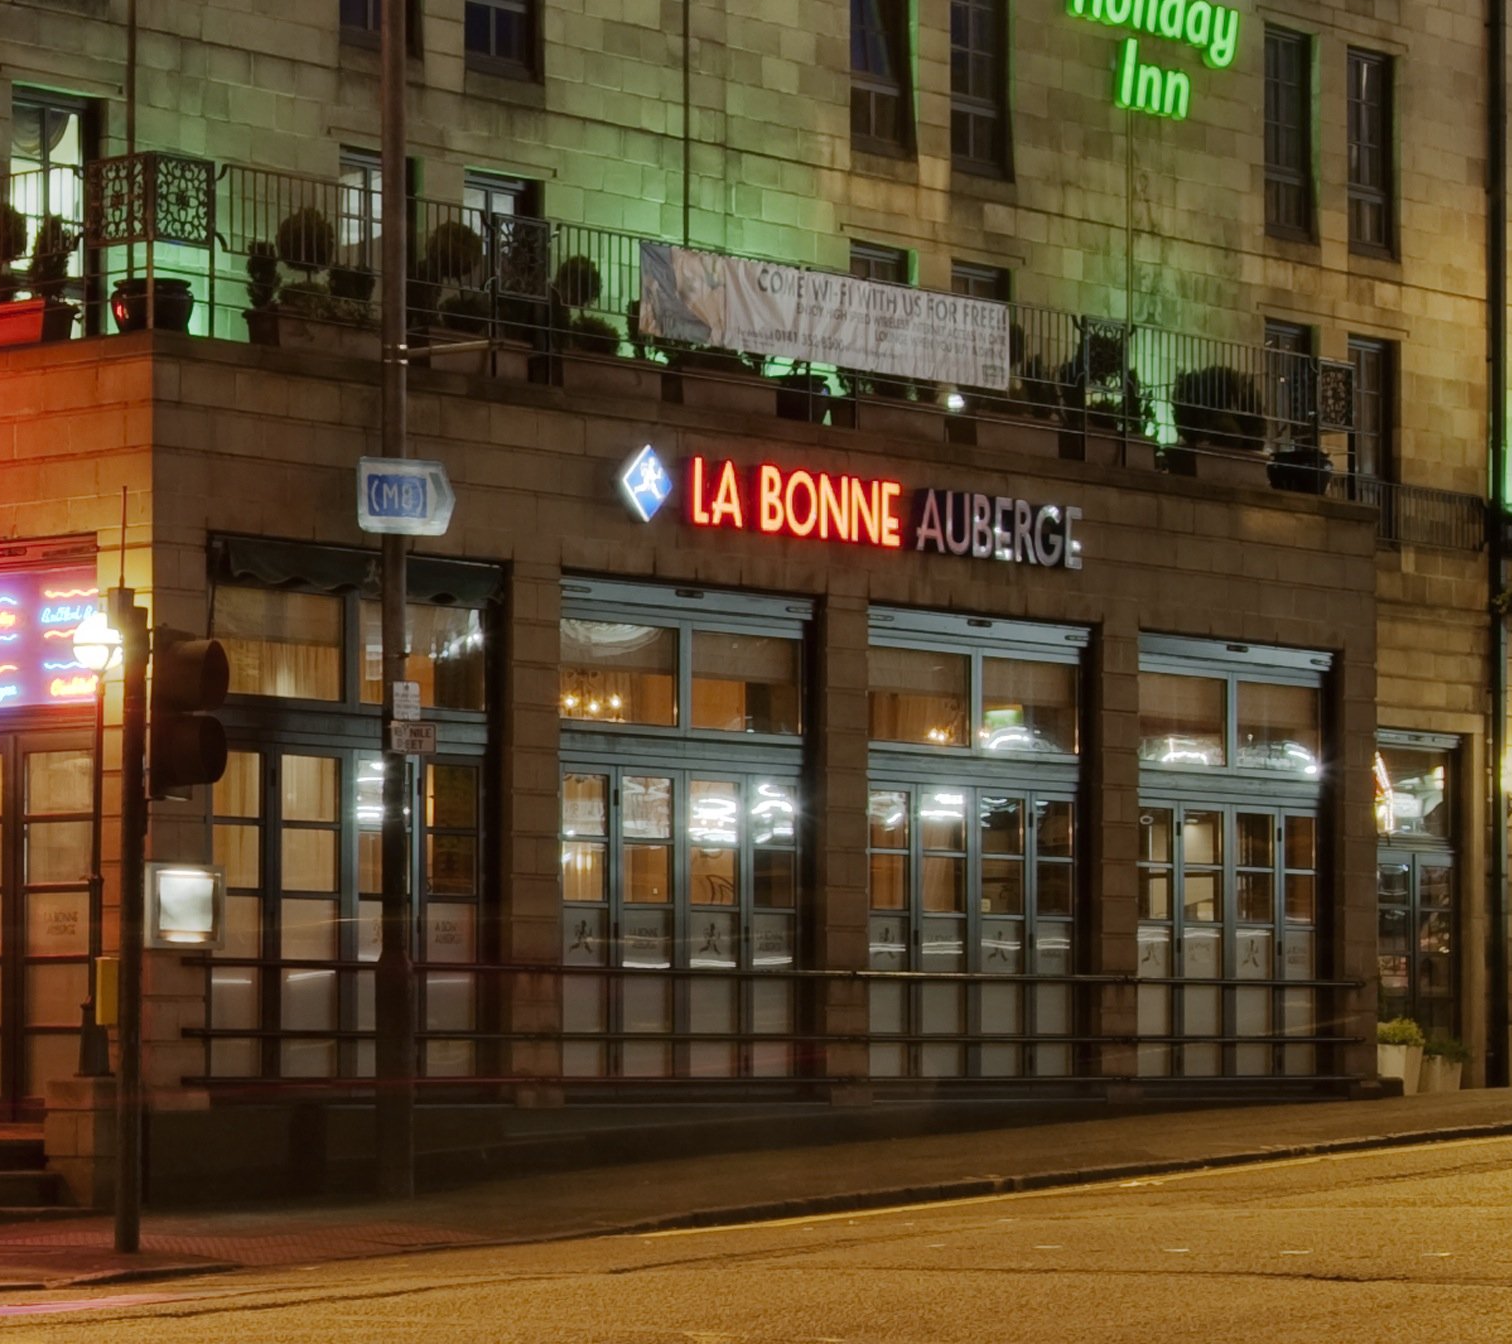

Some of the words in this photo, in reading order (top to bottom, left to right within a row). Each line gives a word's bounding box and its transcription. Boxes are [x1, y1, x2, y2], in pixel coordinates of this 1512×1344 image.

[1116, 37, 1191, 120] Inn
[757, 268, 804, 299] COME
[812, 278, 852, 307] WI-FI
[857, 285, 897, 314] WITH
[902, 292, 921, 317] US
[927, 297, 957, 324] FOR
[692, 457, 743, 528] LA
[759, 464, 901, 547] BONNE
[916, 488, 1083, 570] AUBERGE
[409, 727, 432, 738] NILE
